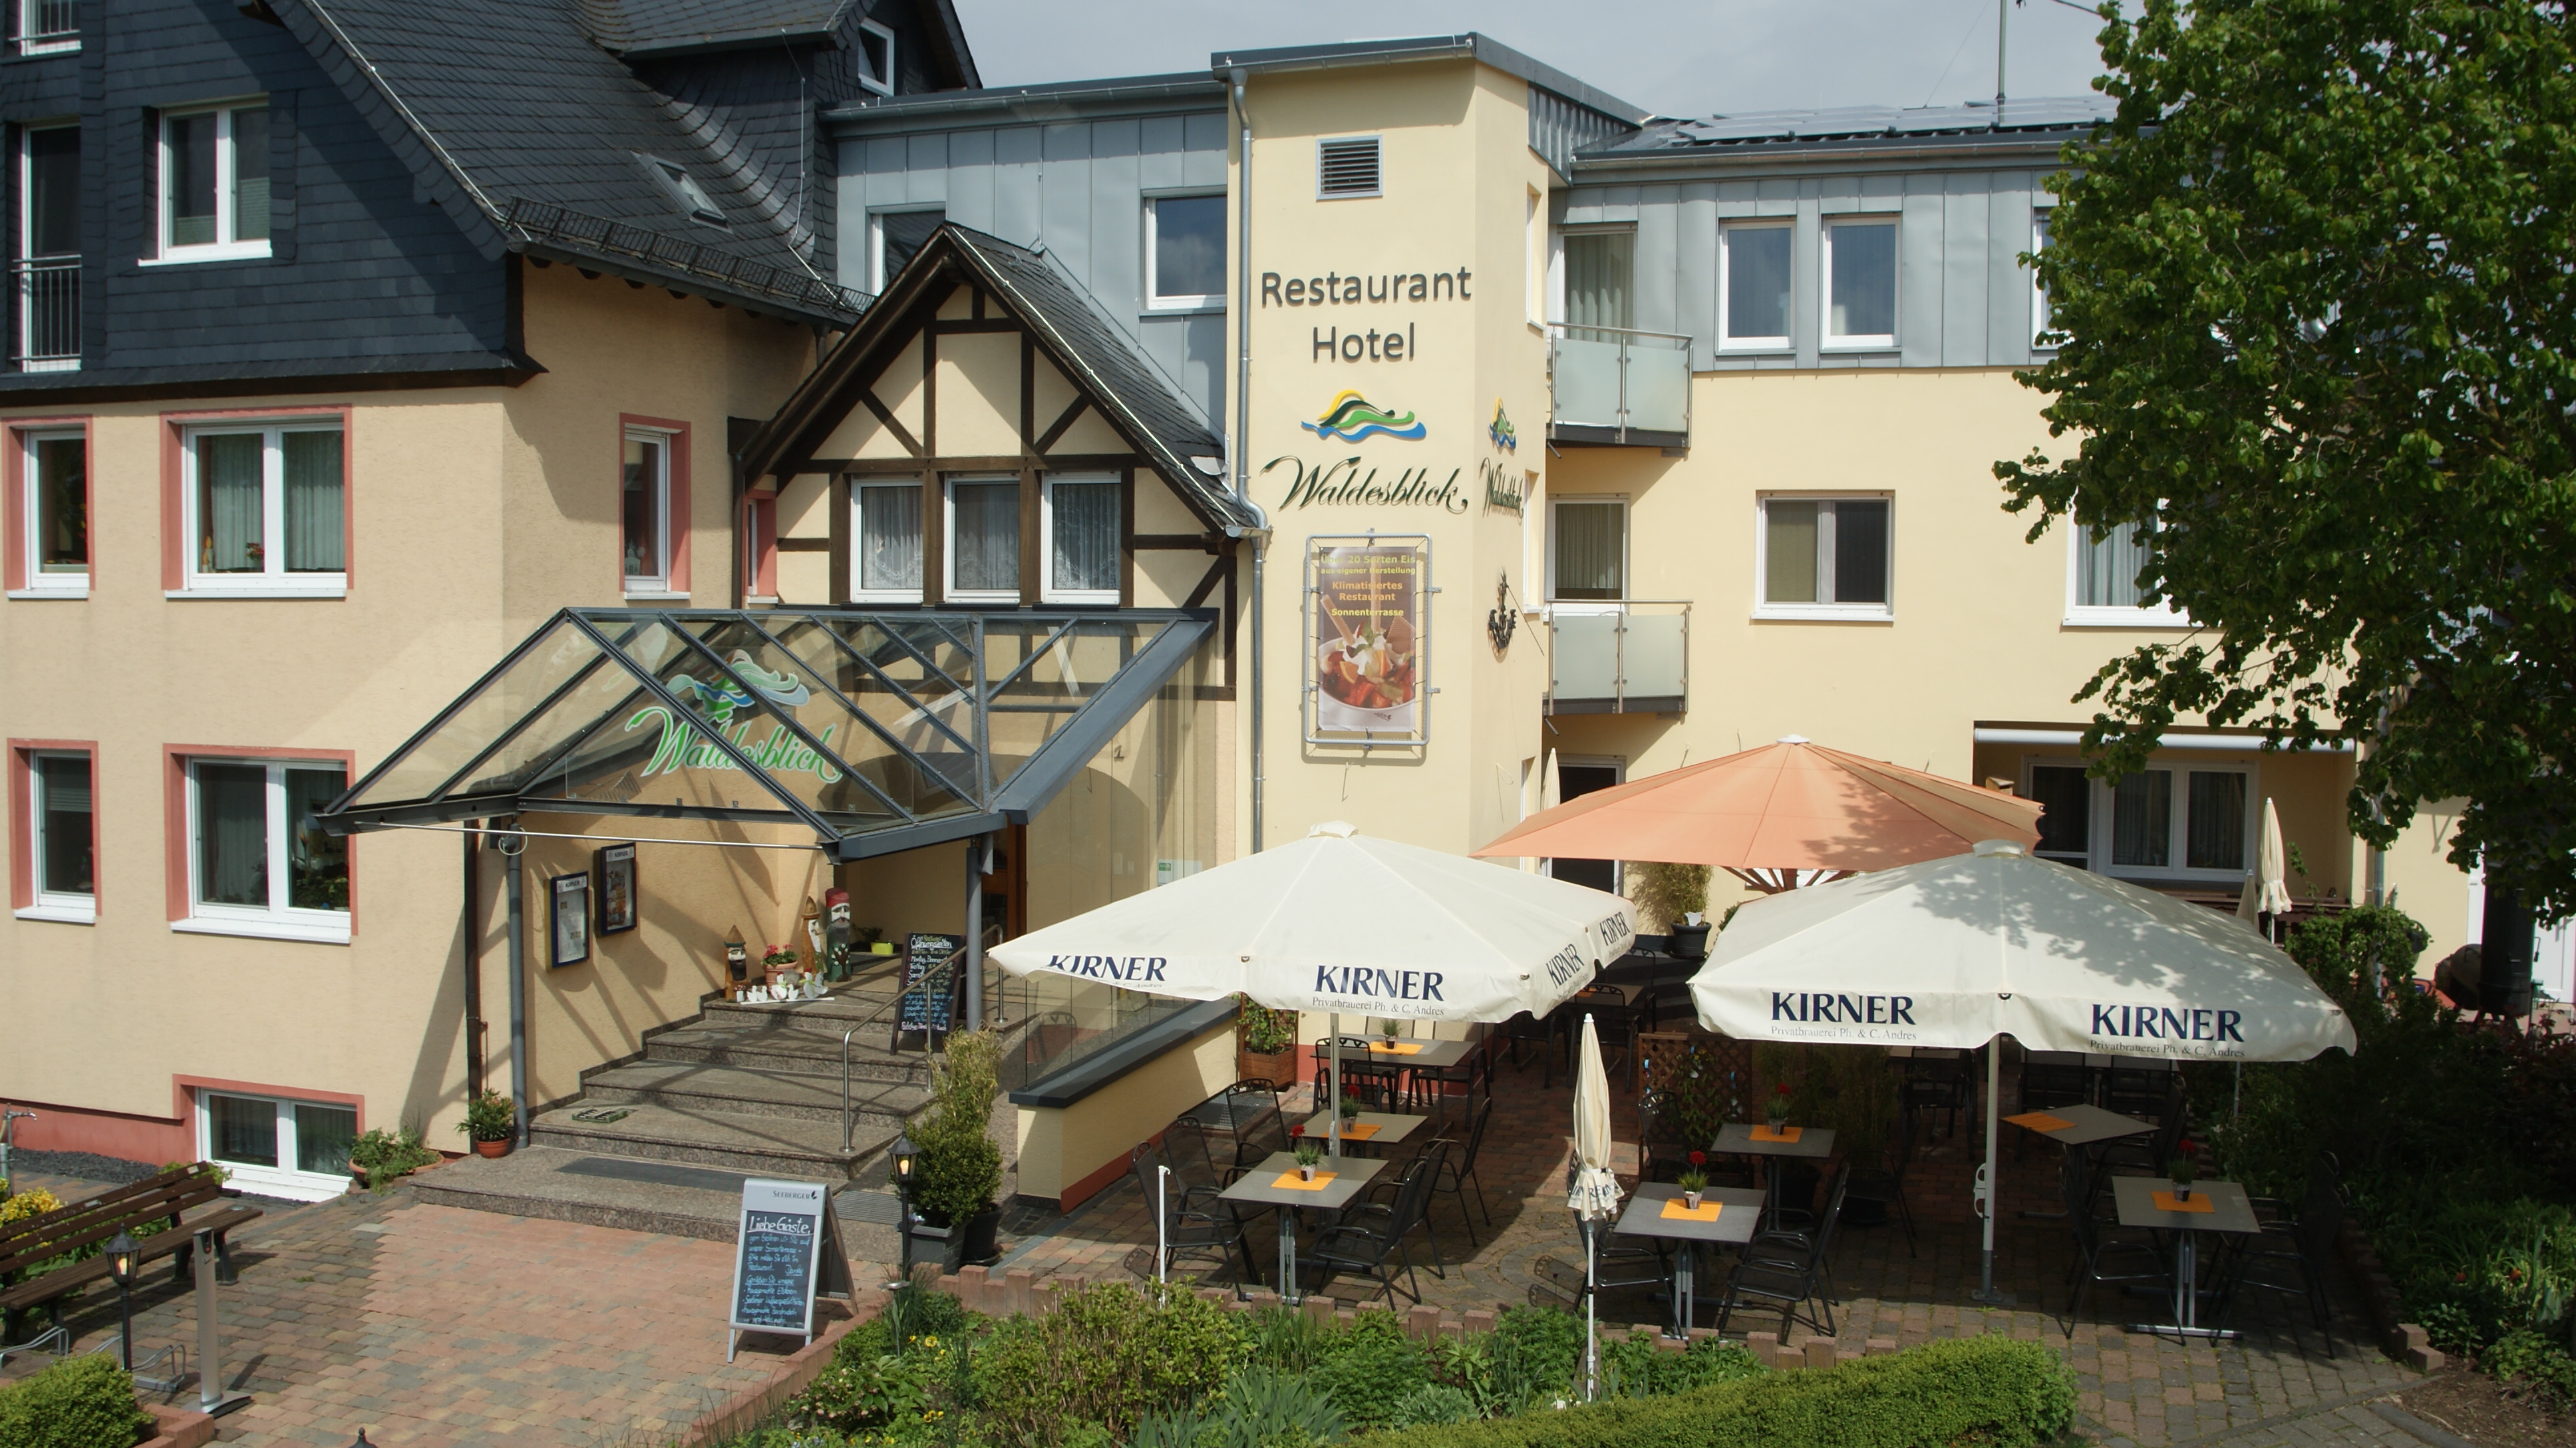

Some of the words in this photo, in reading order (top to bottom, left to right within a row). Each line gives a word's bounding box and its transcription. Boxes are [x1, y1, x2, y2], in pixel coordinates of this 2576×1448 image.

[1262, 266, 1472, 307] Restaurant
[1313, 322, 1414, 361] Hotel
[1259, 455, 1468, 514] Waldesblick
[1364, 555, 1397, 564] Sorten
[1400, 555, 1416, 564] Eis
[1337, 567, 1367, 576] eigener
[1369, 567, 1416, 576] Herstellung
[1332, 581, 1403, 590] Klimatisiertes
[1339, 592, 1396, 601] Restaurant
[1331, 608, 1404, 616] Sonnenterrasse
[1046, 955, 1168, 982] KIRNER
[1545, 944, 1585, 989] KIRNER
[1315, 965, 1445, 1001] KIRNER
[1313, 997, 1372, 1010] Privatbrauerei
[1374, 1001, 1388, 1012] Ph.
[1402, 1004, 1411, 1013] C.
[1414, 1005, 1444, 1015] Andres
[1771, 992, 1917, 1025] KIRNER
[2091, 1003, 2245, 1043] KIRNER
[1771, 1025, 1836, 1037] Privatbrauerei
[1840, 1027, 1853, 1037] Ph.
[1857, 1029, 1866, 1038] &
[1869, 1029, 1880, 1039] C.
[1883, 1029, 1917, 1040] Andres
[2090, 1039, 2160, 1053] Privatbrauerei
[2164, 1044, 2177, 1053] Ph.
[2181, 1045, 2191, 1055] &
[2195, 1045, 2206, 1056] C.
[2209, 1047, 2245, 1057] Andres
[773, 1190, 810, 1200] SEEBERGER
[749, 1216, 776, 1230] Liebe
